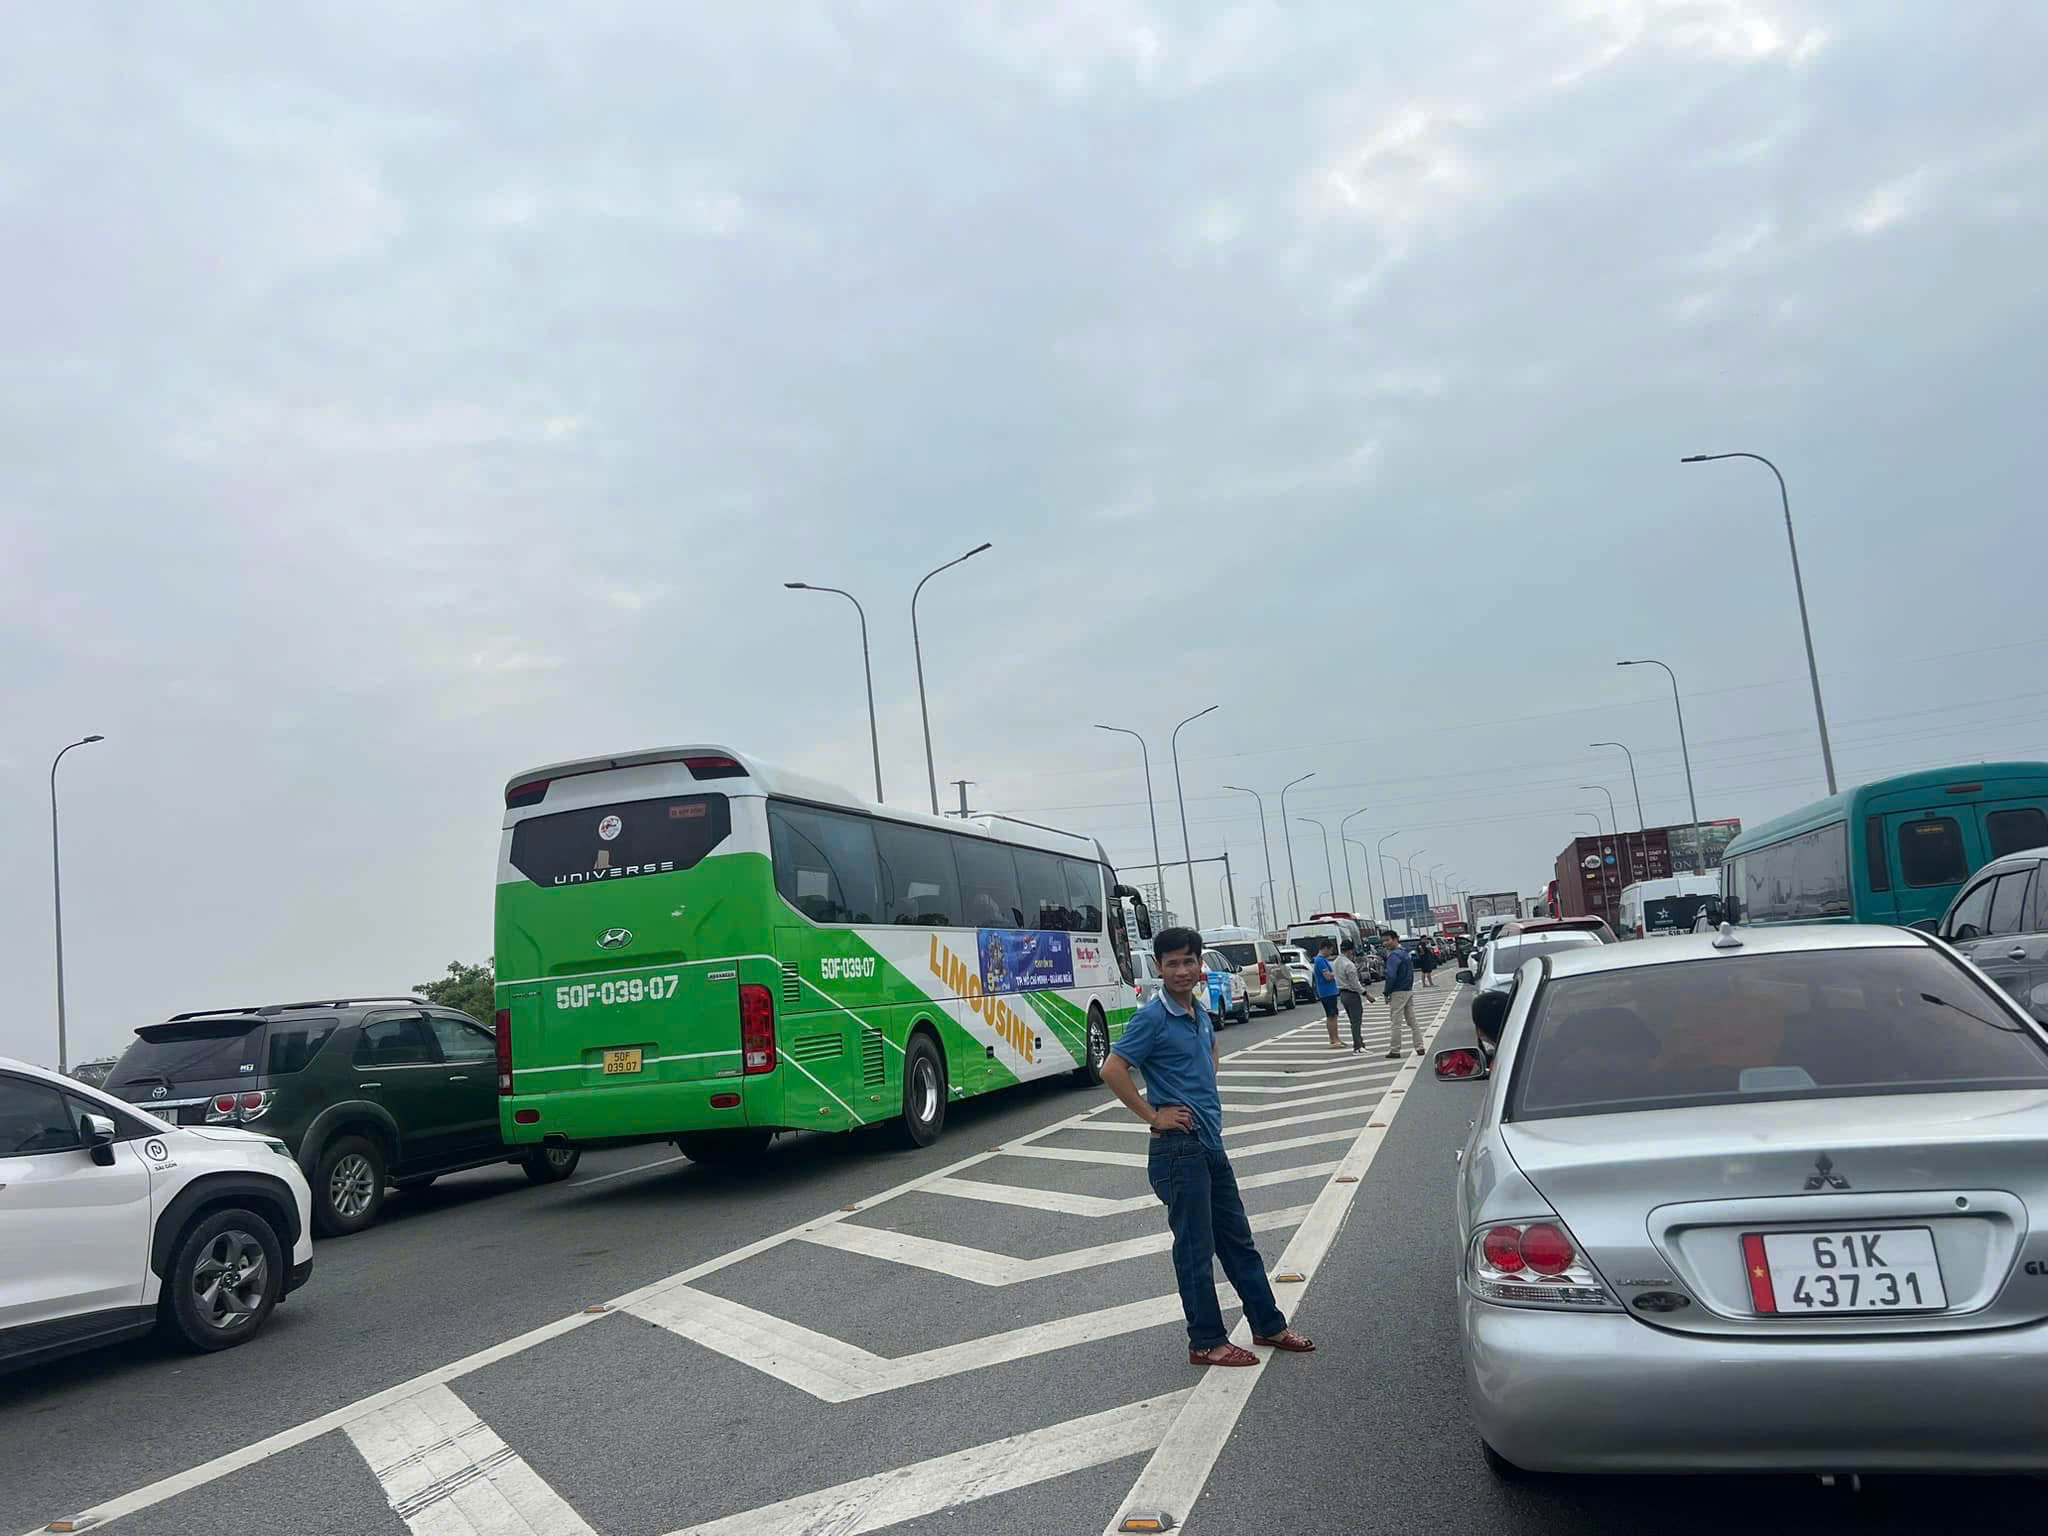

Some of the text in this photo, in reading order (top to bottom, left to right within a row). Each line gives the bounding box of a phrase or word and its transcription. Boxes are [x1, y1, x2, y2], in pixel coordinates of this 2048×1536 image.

[554, 861, 674, 884] UNIVERSE
[930, 933, 1034, 1065] LIMOUSINE
[607, 1062, 637, 1073] 039.07
[614, 1052, 631, 1062] 50F
[1812, 1234, 1888, 1269] 61K
[2024, 1260, 2048, 1275] GL
[1793, 1271, 1923, 1308] 437.31
